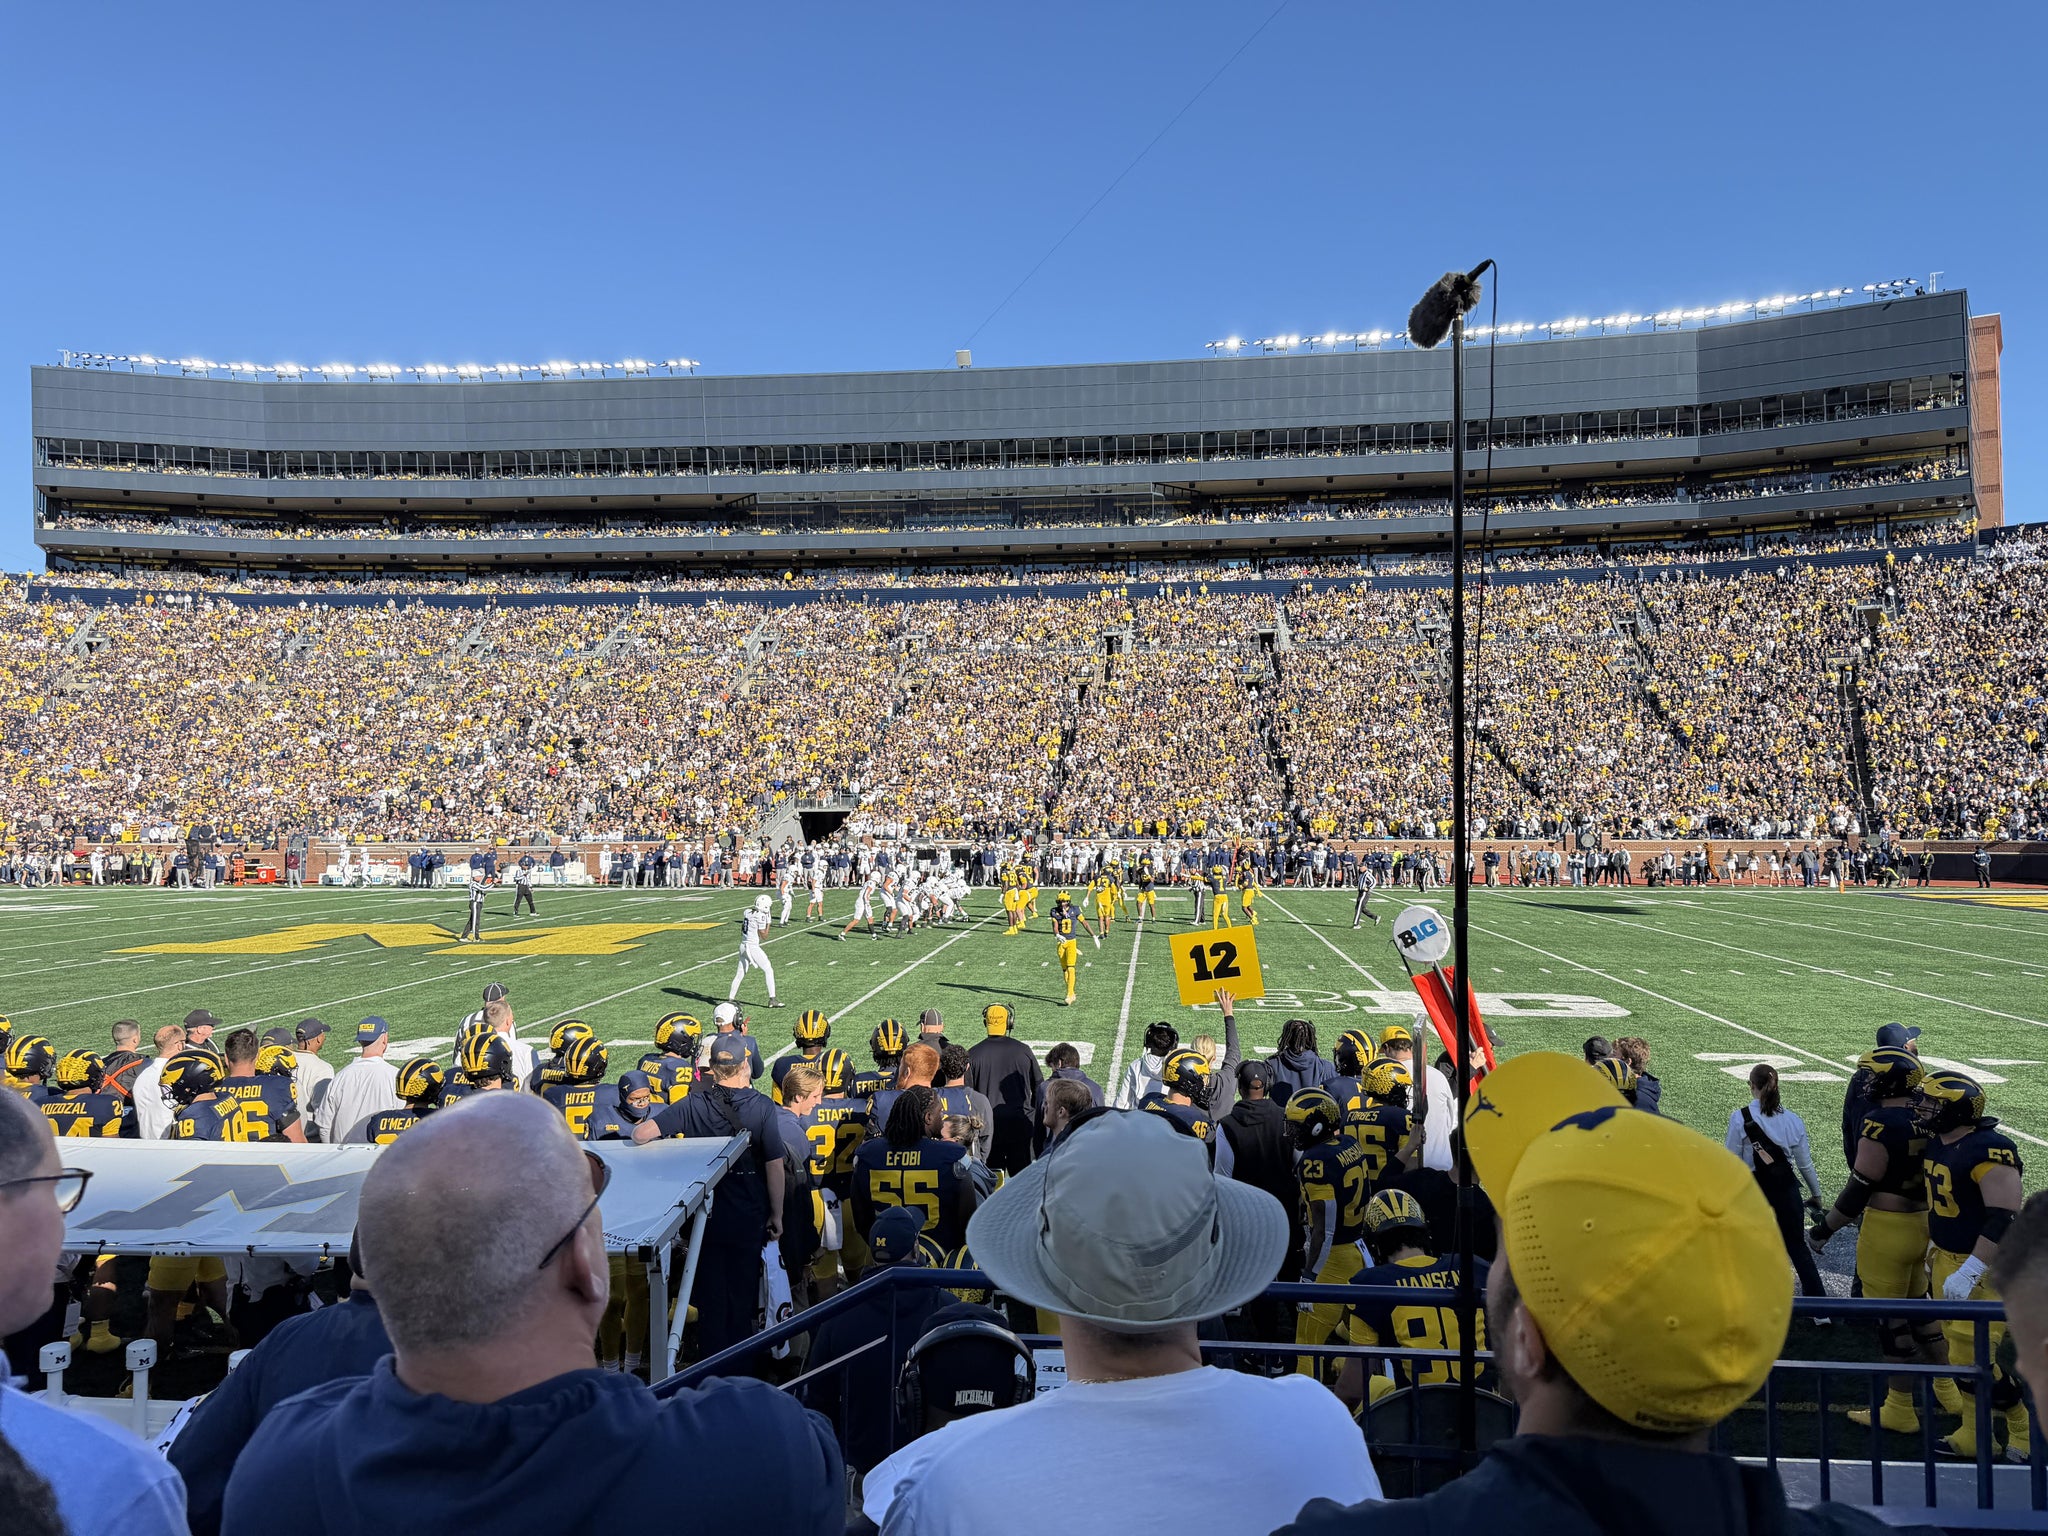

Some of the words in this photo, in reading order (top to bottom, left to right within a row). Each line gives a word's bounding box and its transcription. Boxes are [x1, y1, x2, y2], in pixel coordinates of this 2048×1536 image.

[1062, 918, 1072, 934] 0
[1189, 941, 1241, 982] 12
[675, 1067, 693, 1082] 25
[565, 1091, 595, 1105] HITER
[817, 1107, 853, 1122] STACY
[1347, 1111, 1380, 1122] FORBES
[179, 1118, 195, 1137] 18
[1192, 1121, 1208, 1139] 46
[1862, 1119, 1885, 1140] 77
[806, 1123, 866, 1175] 32
[1987, 1147, 2015, 1166] 53
[886, 1150, 921, 1167] EFOBI
[1303, 1159, 1324, 1178] 23
[827, 1200, 840, 1210] M
[869, 1169, 940, 1231] 55
[876, 1236, 887, 1247] M
[54, 1354, 67, 1364] M
[138, 1357, 151, 1367] M
[955, 1389, 995, 1407] MICHIGAN
